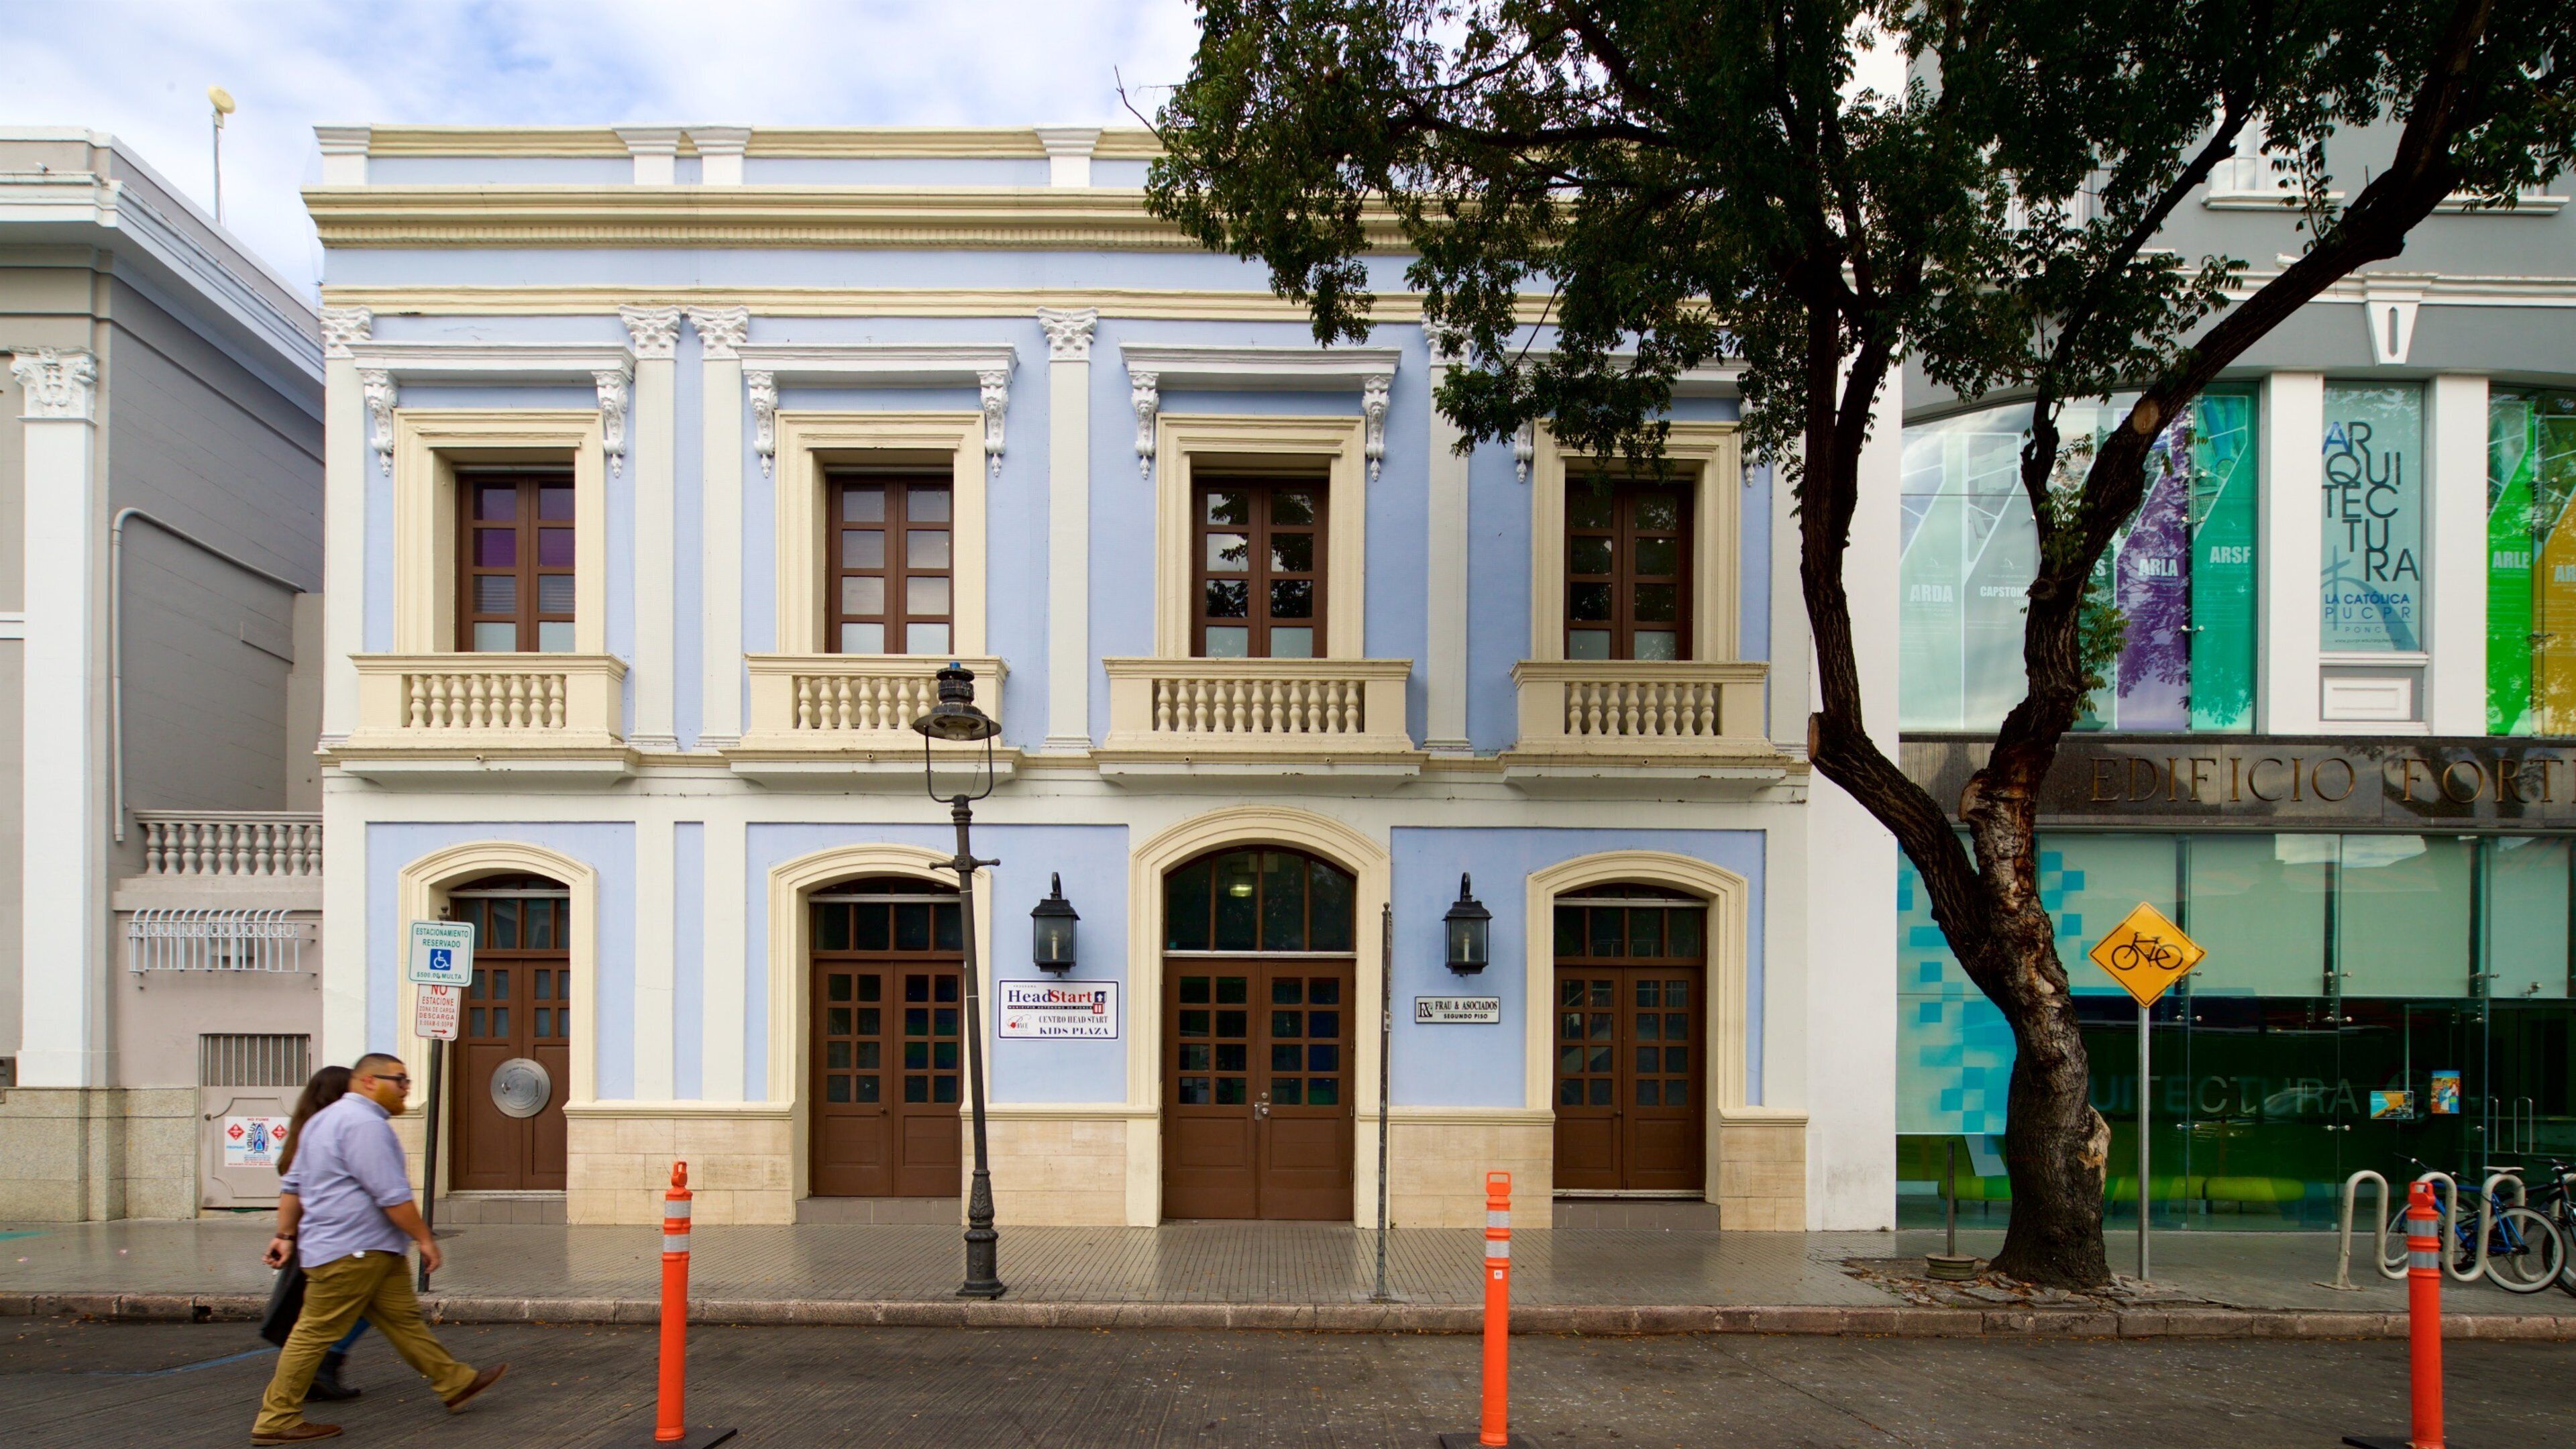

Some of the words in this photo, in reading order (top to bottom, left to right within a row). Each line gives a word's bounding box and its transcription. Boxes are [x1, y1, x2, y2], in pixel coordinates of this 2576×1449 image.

[2322, 421, 2372, 455] AR
[2326, 451, 2401, 486] QUI
[2322, 484, 2398, 518] TEC
[2342, 519, 2389, 552] TU
[2210, 546, 2251, 564] ARSF
[2492, 551, 2530, 568] ARLE
[2138, 558, 2178, 576] ARLA
[2365, 548, 2420, 582] RA
[1909, 584, 1953, 602] ARDA
[2325, 594, 2340, 604] LA
[2343, 591, 2410, 604] CATÓLICA
[2090, 757, 2356, 803] EDIFICIO
[416, 928, 468, 938] ESTACIONAMIENTO
[431, 984, 447, 996] NO
[422, 996, 454, 1006] ESTACIONE
[1435, 1001, 1452, 1010] FRAU
[1454, 1002, 1459, 1010] &
[1462, 1001, 1497, 1010] ASOCIADOS
[1087, 1016, 1108, 1024] START
[246, 1122, 258, 1152] LIQUILUX
